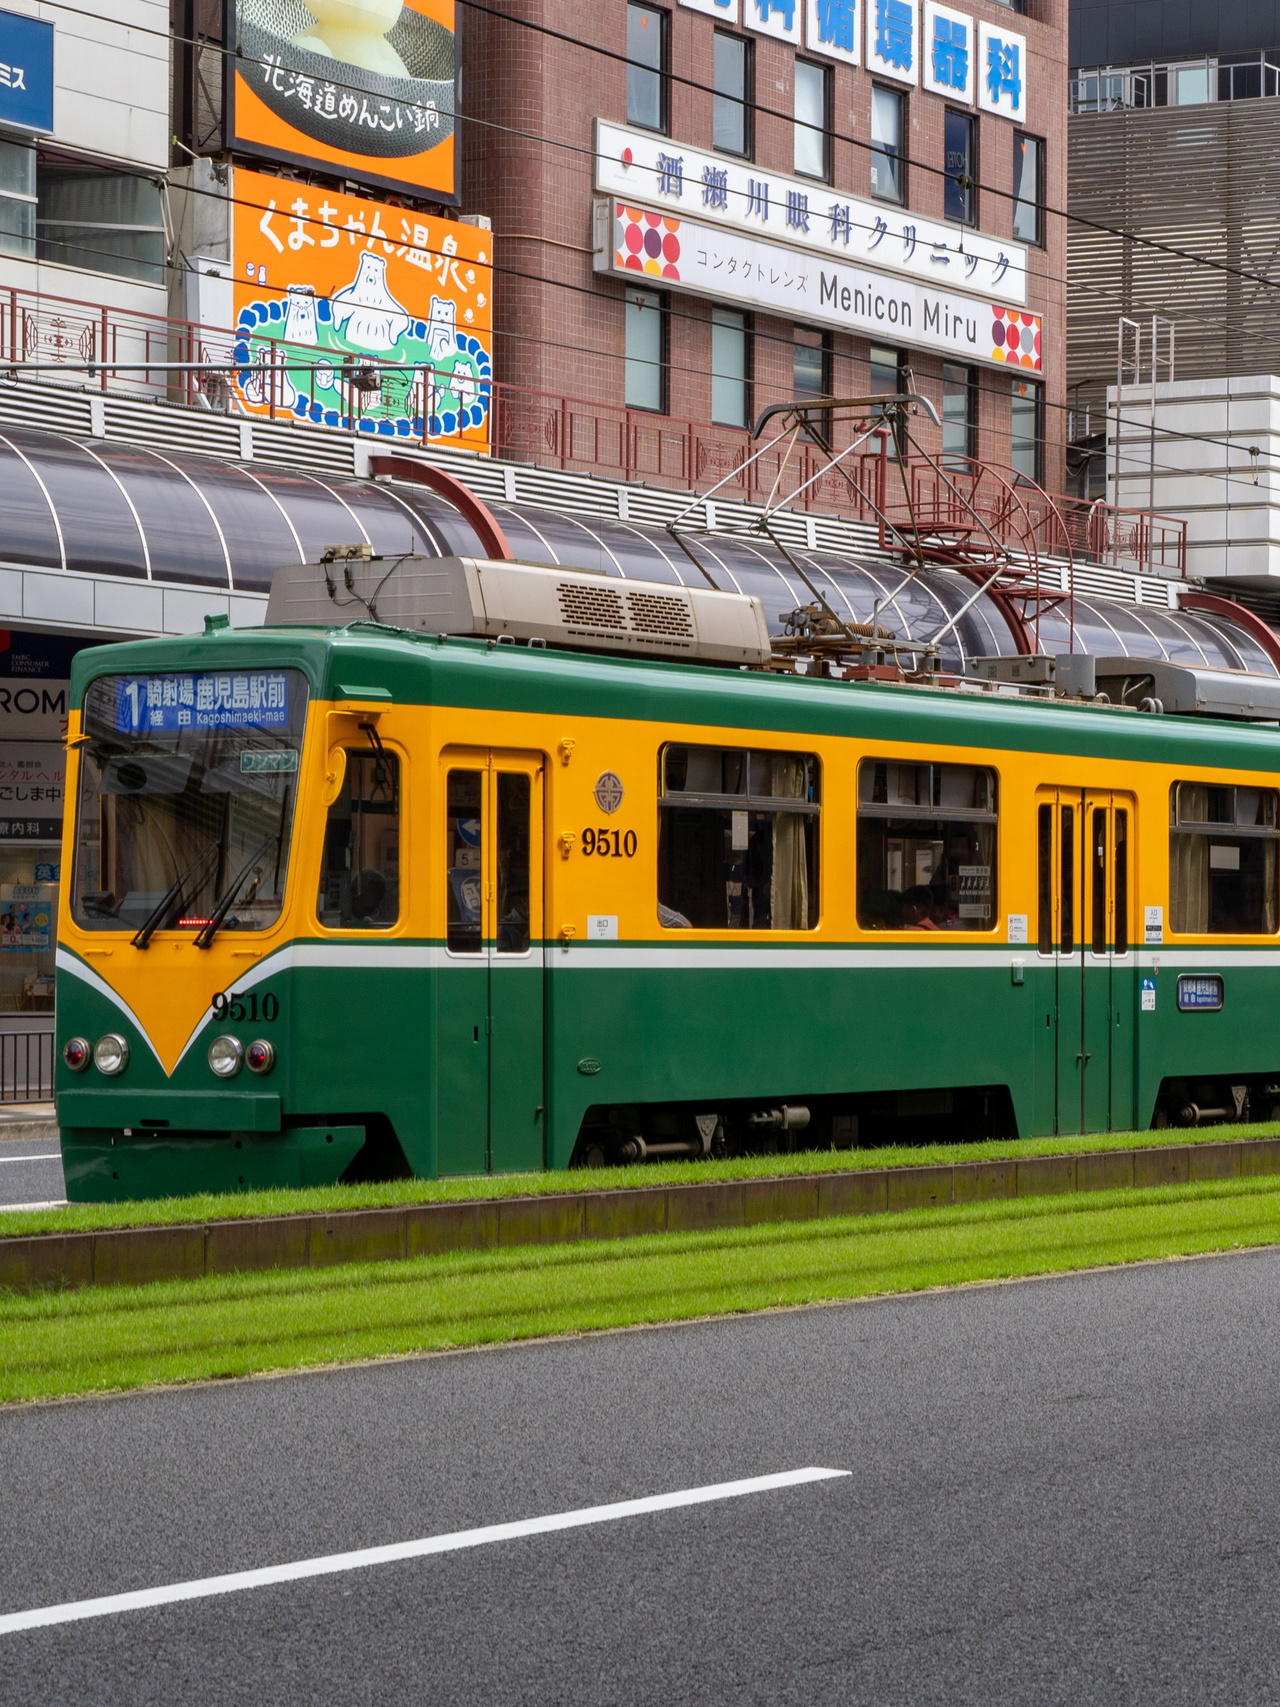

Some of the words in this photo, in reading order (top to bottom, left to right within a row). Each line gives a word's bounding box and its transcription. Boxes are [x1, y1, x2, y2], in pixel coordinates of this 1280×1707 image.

[261, 53, 440, 131] 北海道めんこい鍋
[656, 151, 1012, 286] 酒瀬川眼科クリニック
[259, 197, 468, 293] くまちゃん温泉
[697, 249, 808, 293] コンタクトレンズ
[819, 270, 912, 328] Menicon
[923, 302, 977, 345] Miru
[126, 681, 139, 727] 1
[147, 678, 193, 708] 騎射場
[197, 674, 286, 711] 鹿児島駅前
[197, 709, 285, 726] Kagoshimaeki-mae
[243, 754, 295, 770] ワンマン
[582, 827, 638, 858] 9510
[212, 992, 279, 1023] 9510
